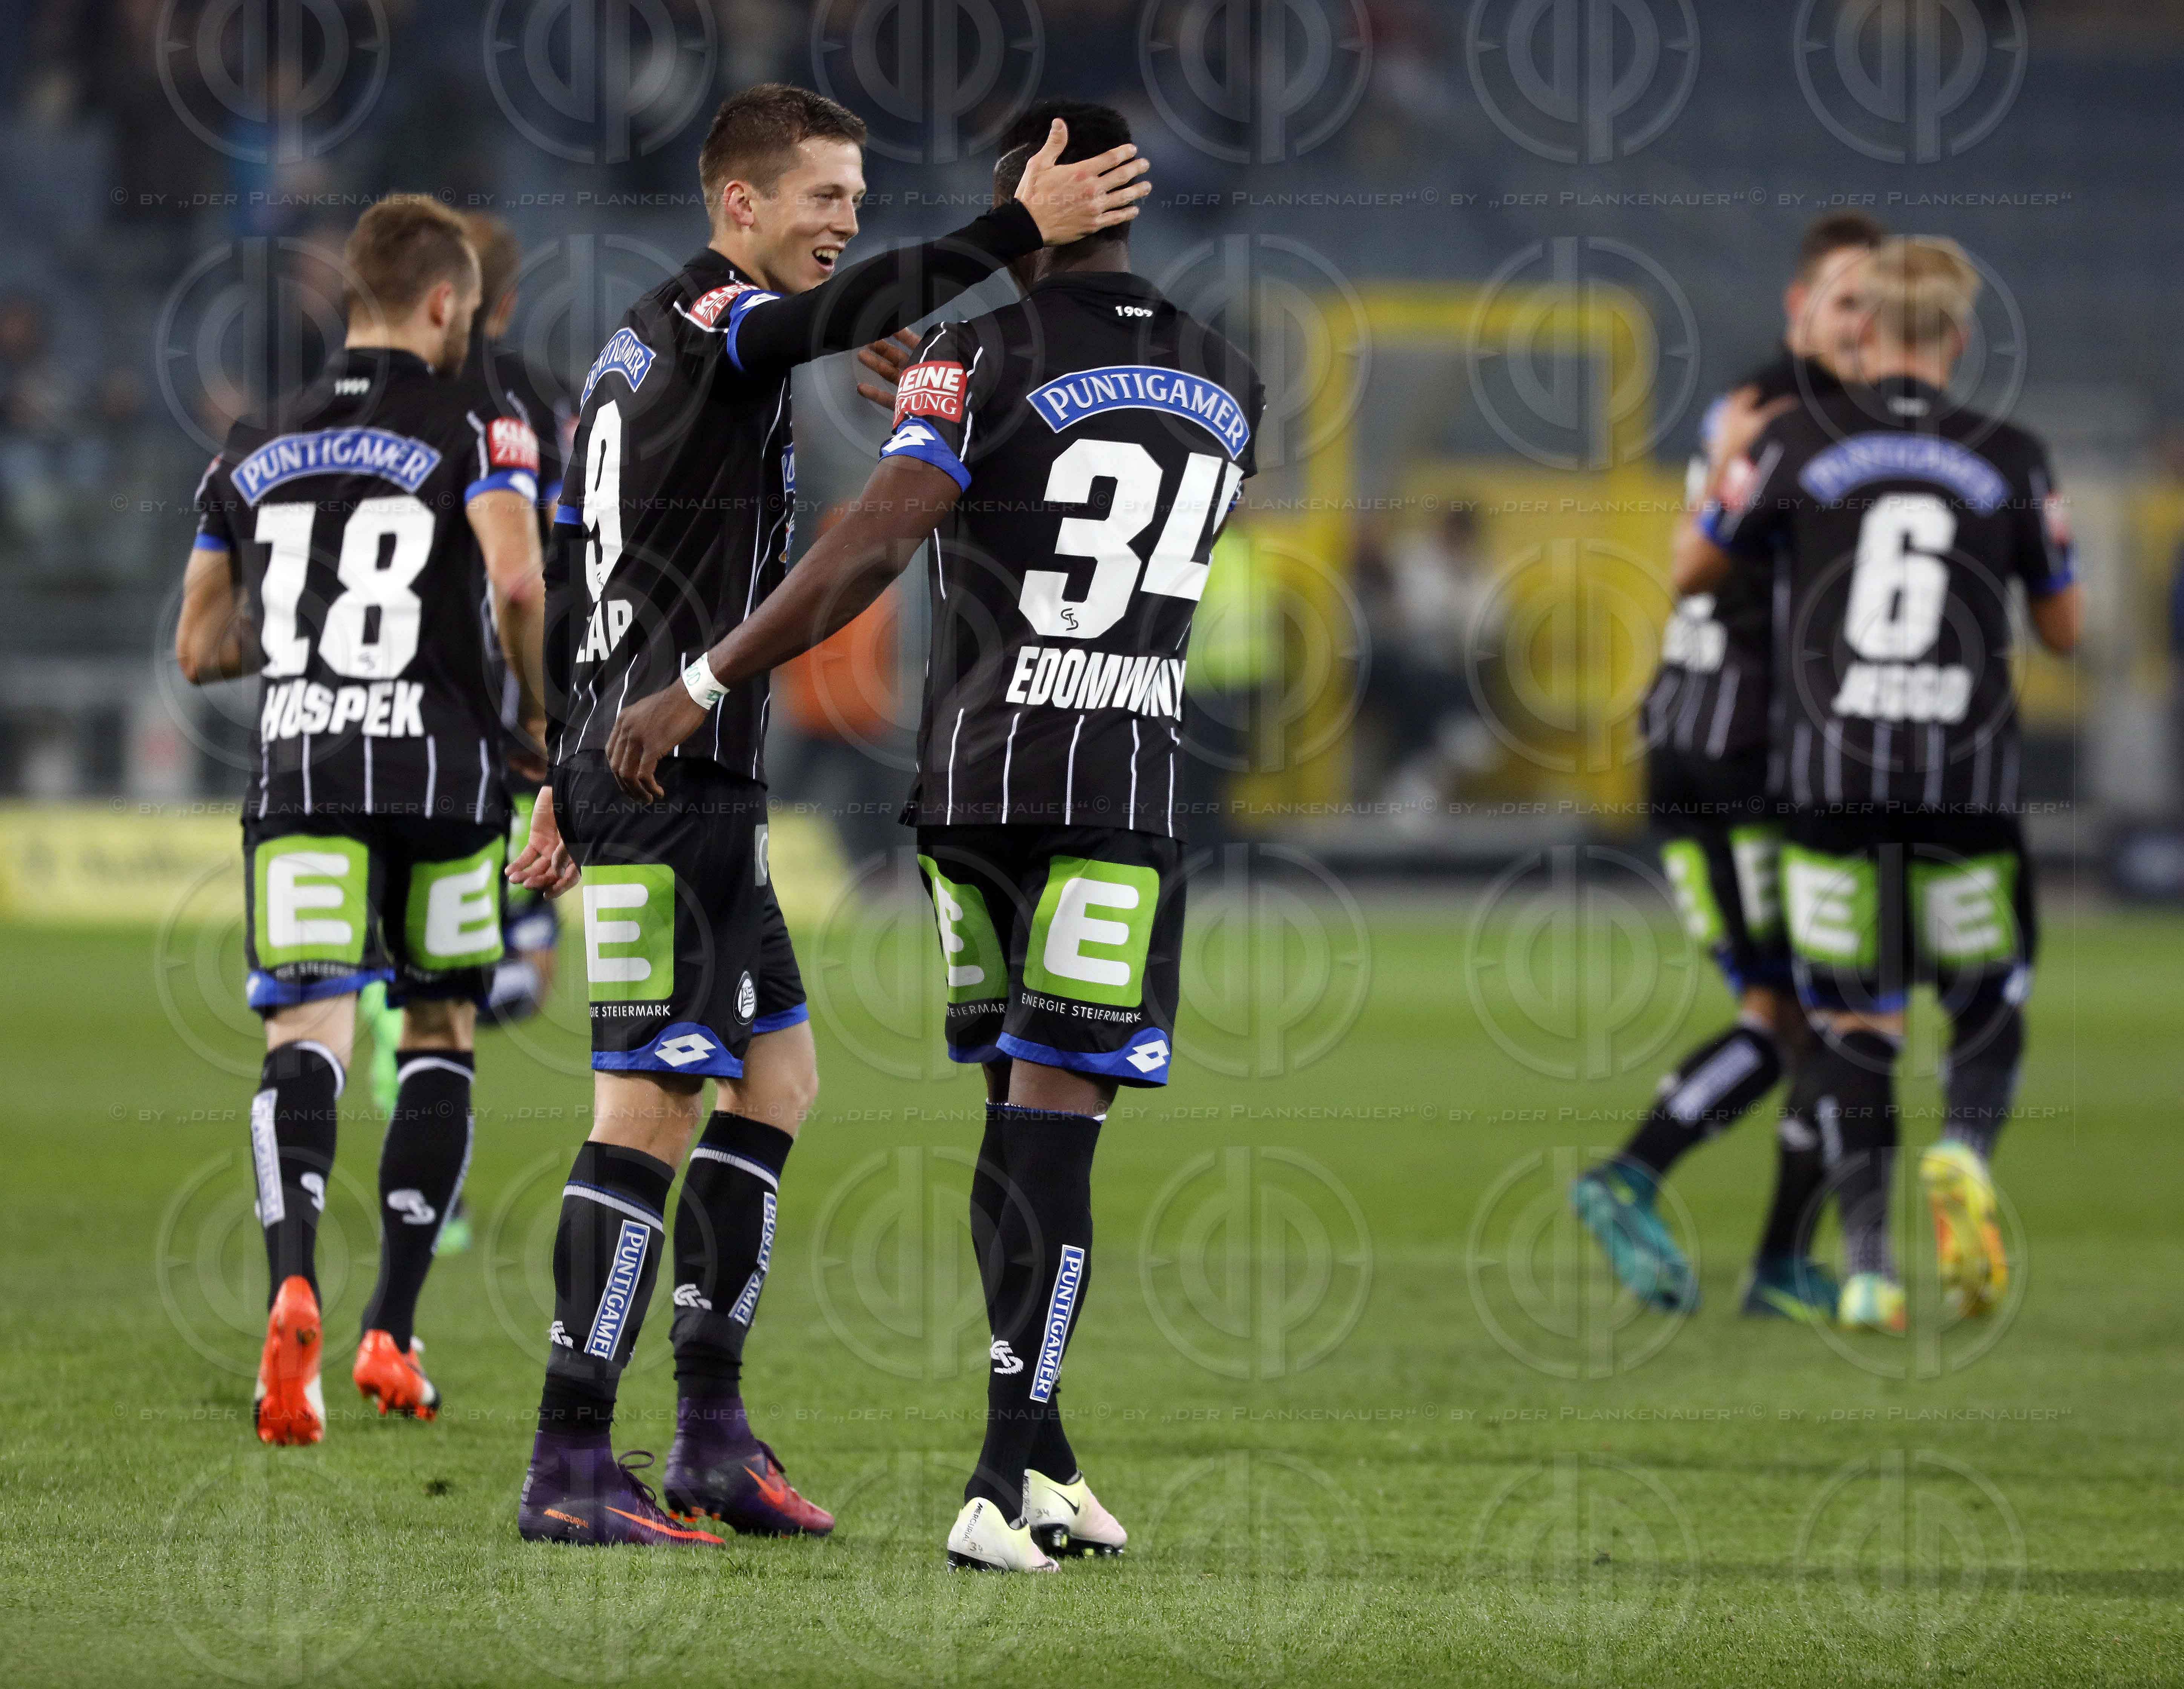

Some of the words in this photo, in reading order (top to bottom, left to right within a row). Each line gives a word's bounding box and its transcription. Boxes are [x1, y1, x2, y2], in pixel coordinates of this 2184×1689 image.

[1115, 305, 1154, 317] 1909
[897, 365, 964, 392] LEINE
[1042, 373, 1245, 448] PUNTIGAMER
[1018, 438, 1245, 639] 34
[255, 494, 437, 679] 18
[1843, 492, 1959, 662] 6
[1043, 877, 1140, 986] E
[590, 1006, 599, 1018] GIE
[602, 1005, 671, 1017] STEIERMARK
[1021, 993, 1066, 1014] ENERGIE
[1071, 1005, 1141, 1023] STEIERMARK
[1036, 1255, 1081, 1394] PUNTIGAMER
[962, 1502, 983, 1543] MERCURIAL
